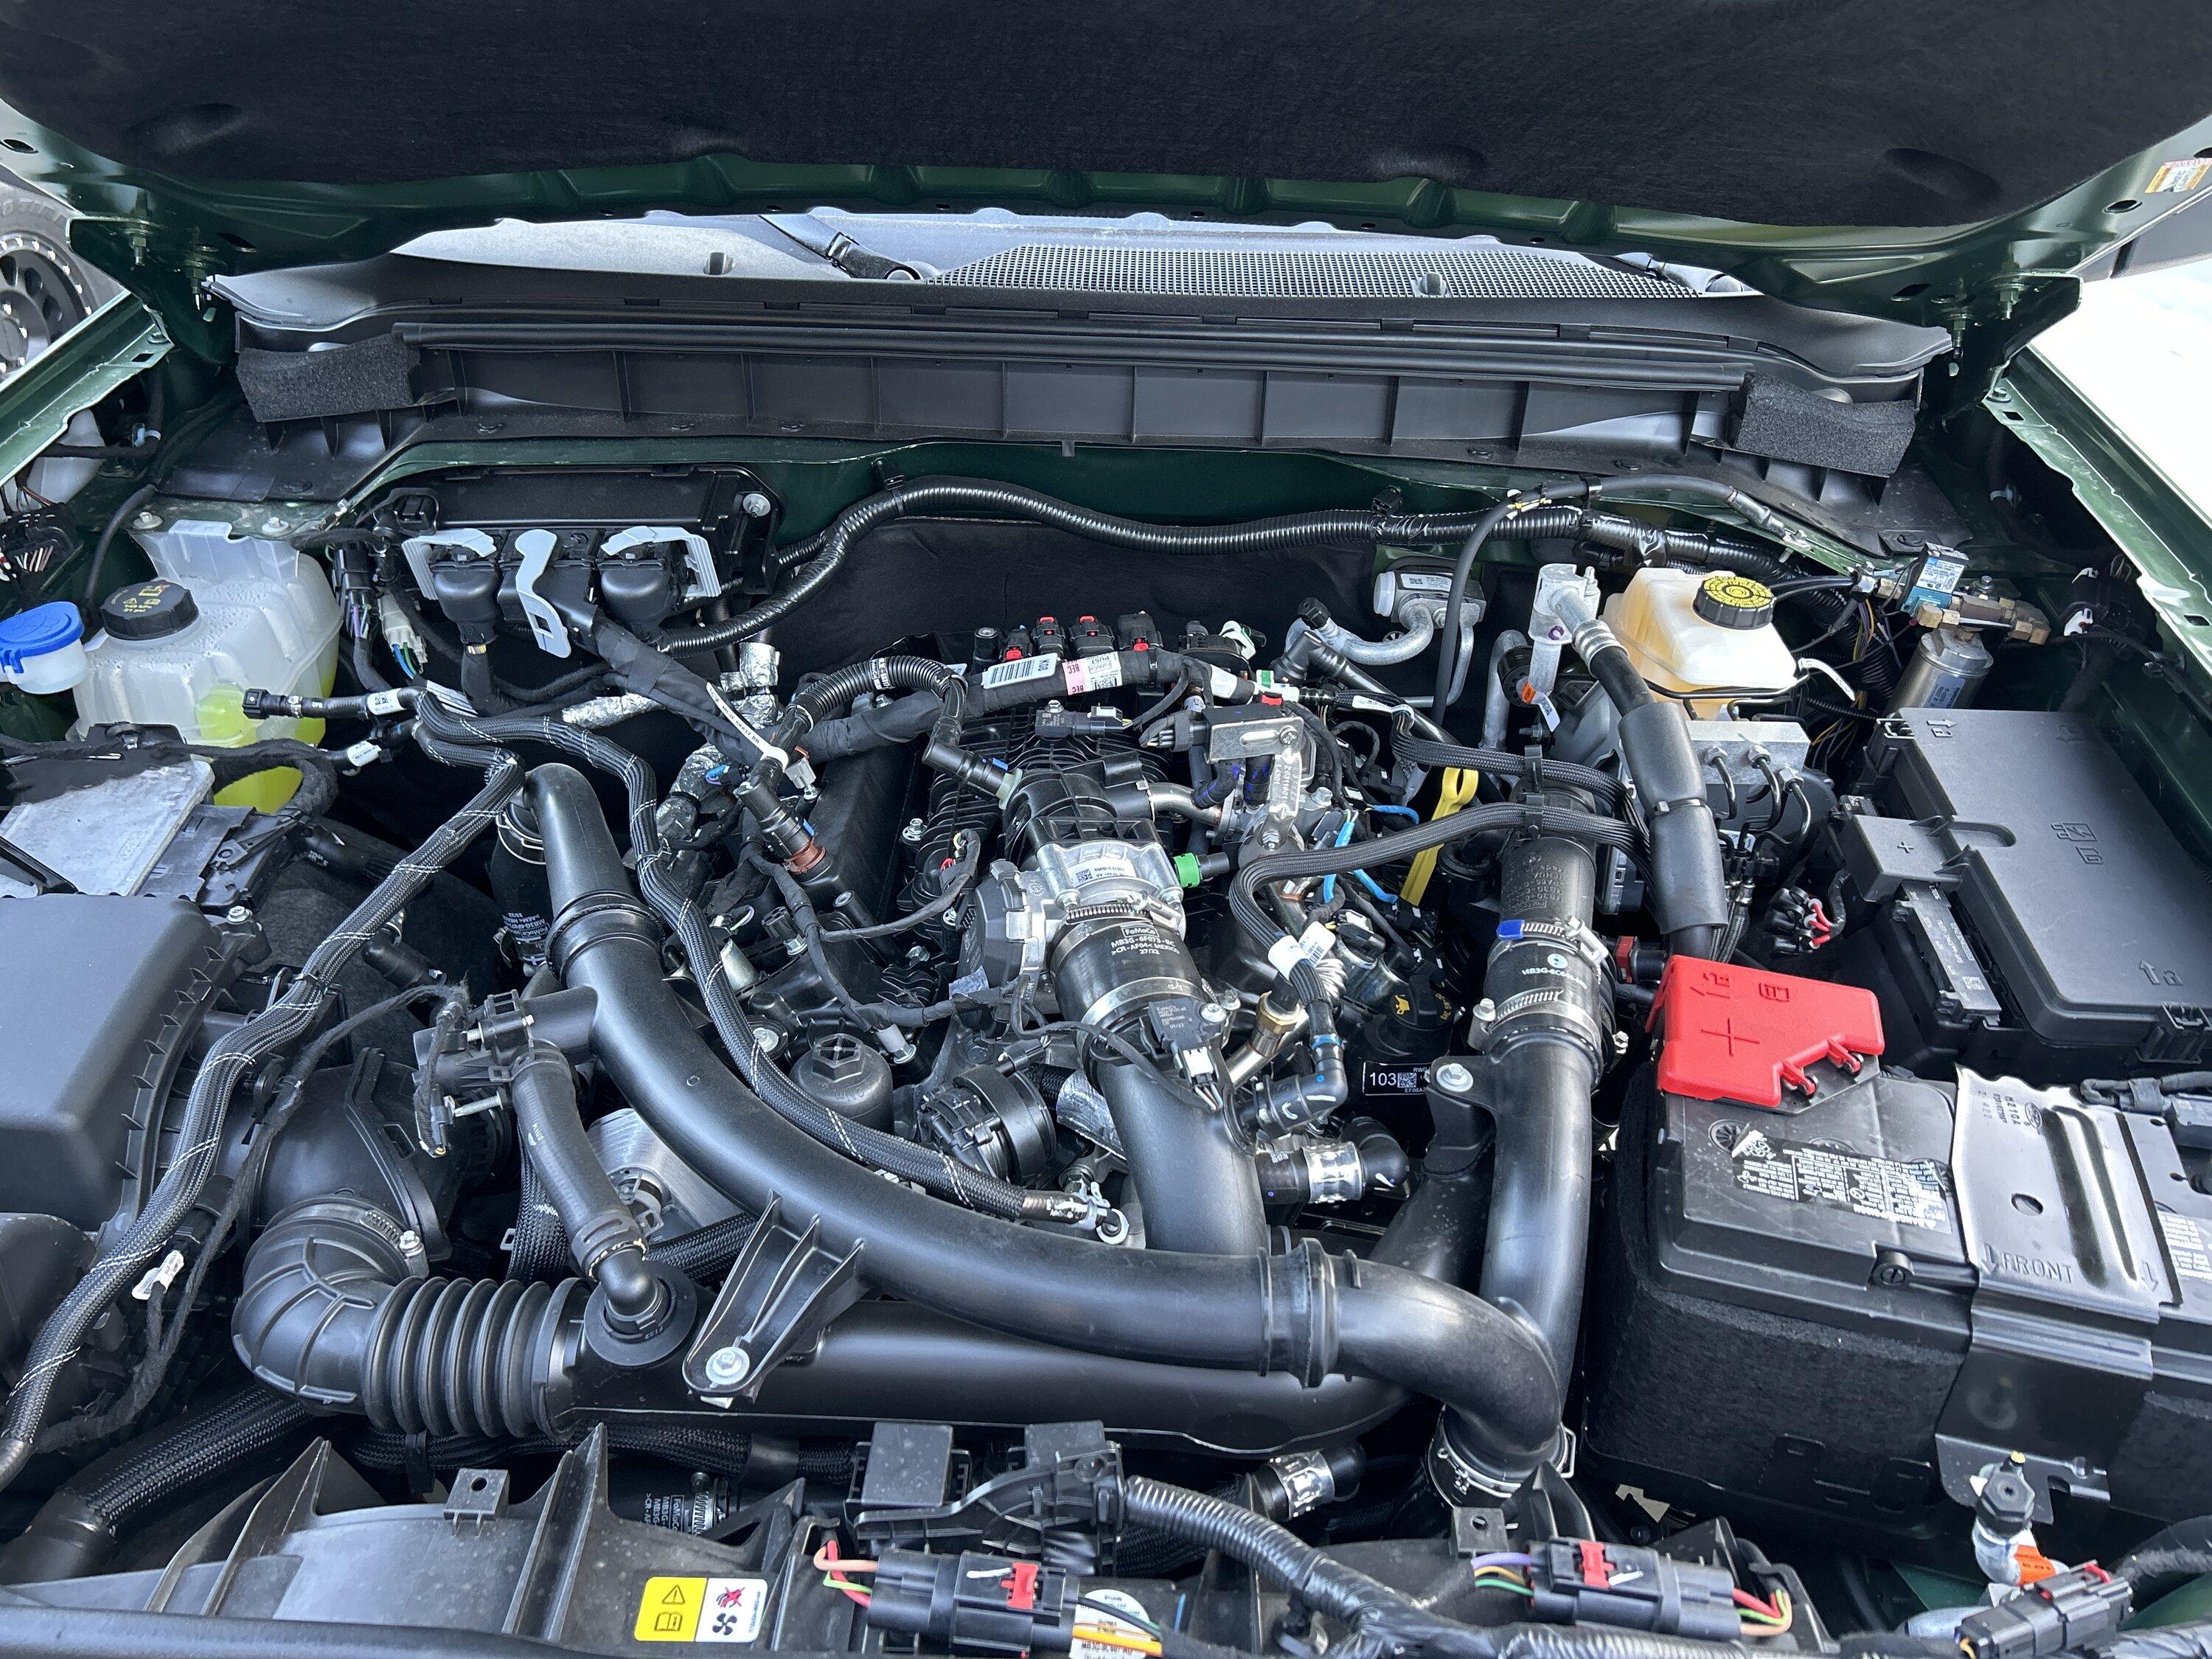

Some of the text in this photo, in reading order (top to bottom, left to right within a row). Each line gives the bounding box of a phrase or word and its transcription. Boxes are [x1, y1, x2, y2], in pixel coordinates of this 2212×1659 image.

[1067, 664, 1080, 674] BEC
[1071, 685, 1084, 693] BEC
[1124, 927, 1157, 936] FoMoCo
[1153, 943, 1180, 956] MEXICO
[1368, 1072, 1397, 1086] 103
[2001, 1252, 2072, 1284] FRONT
